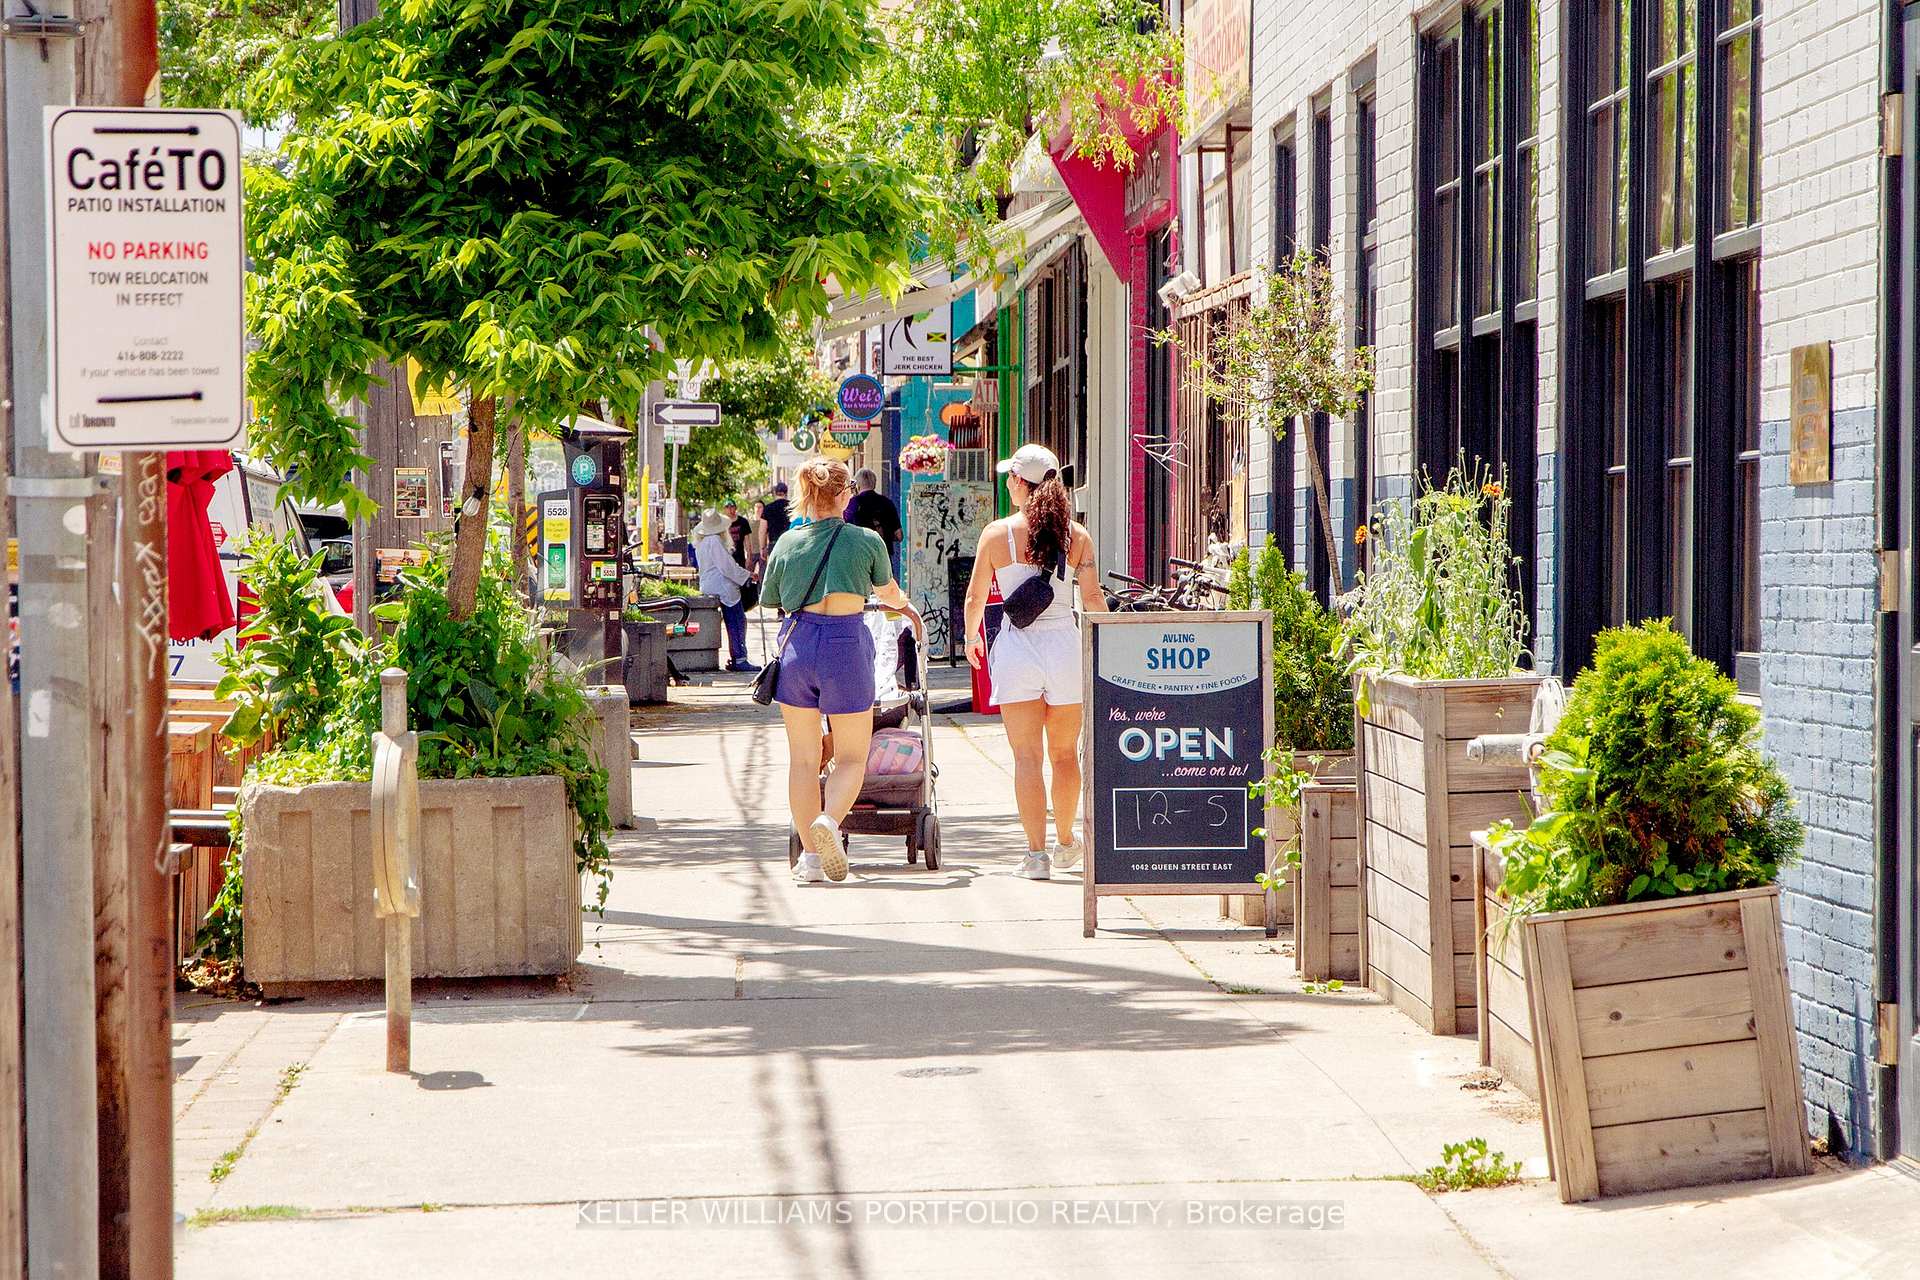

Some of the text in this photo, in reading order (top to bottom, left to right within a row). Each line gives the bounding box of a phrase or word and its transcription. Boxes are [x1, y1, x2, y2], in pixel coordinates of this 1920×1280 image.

[68, 146, 226, 191] CaféTO
[68, 198, 226, 212] PATIO INSTALLATION
[88, 241, 209, 260] NO PARKING
[89, 271, 209, 285] TOW RELOCATION
[116, 292, 183, 306] IN EFFECT
[117, 350, 184, 361] 416-808-2222
[113, 367, 146, 377] vehicle
[547, 507, 568, 517] 5528
[1162, 633, 1195, 643] AVLING
[1147, 647, 1211, 670] SHOP
[1111, 674, 1248, 692] CRAFT BEER PANTRY FINE FOODS
[1108, 706, 1166, 722] Yes, we're
[1118, 726, 1234, 762] OPEN
[1210, 766, 1226, 776] on
[1229, 764, 1249, 776] in!
[1131, 863, 1233, 871] 1042 QUEEN STREET EAST
